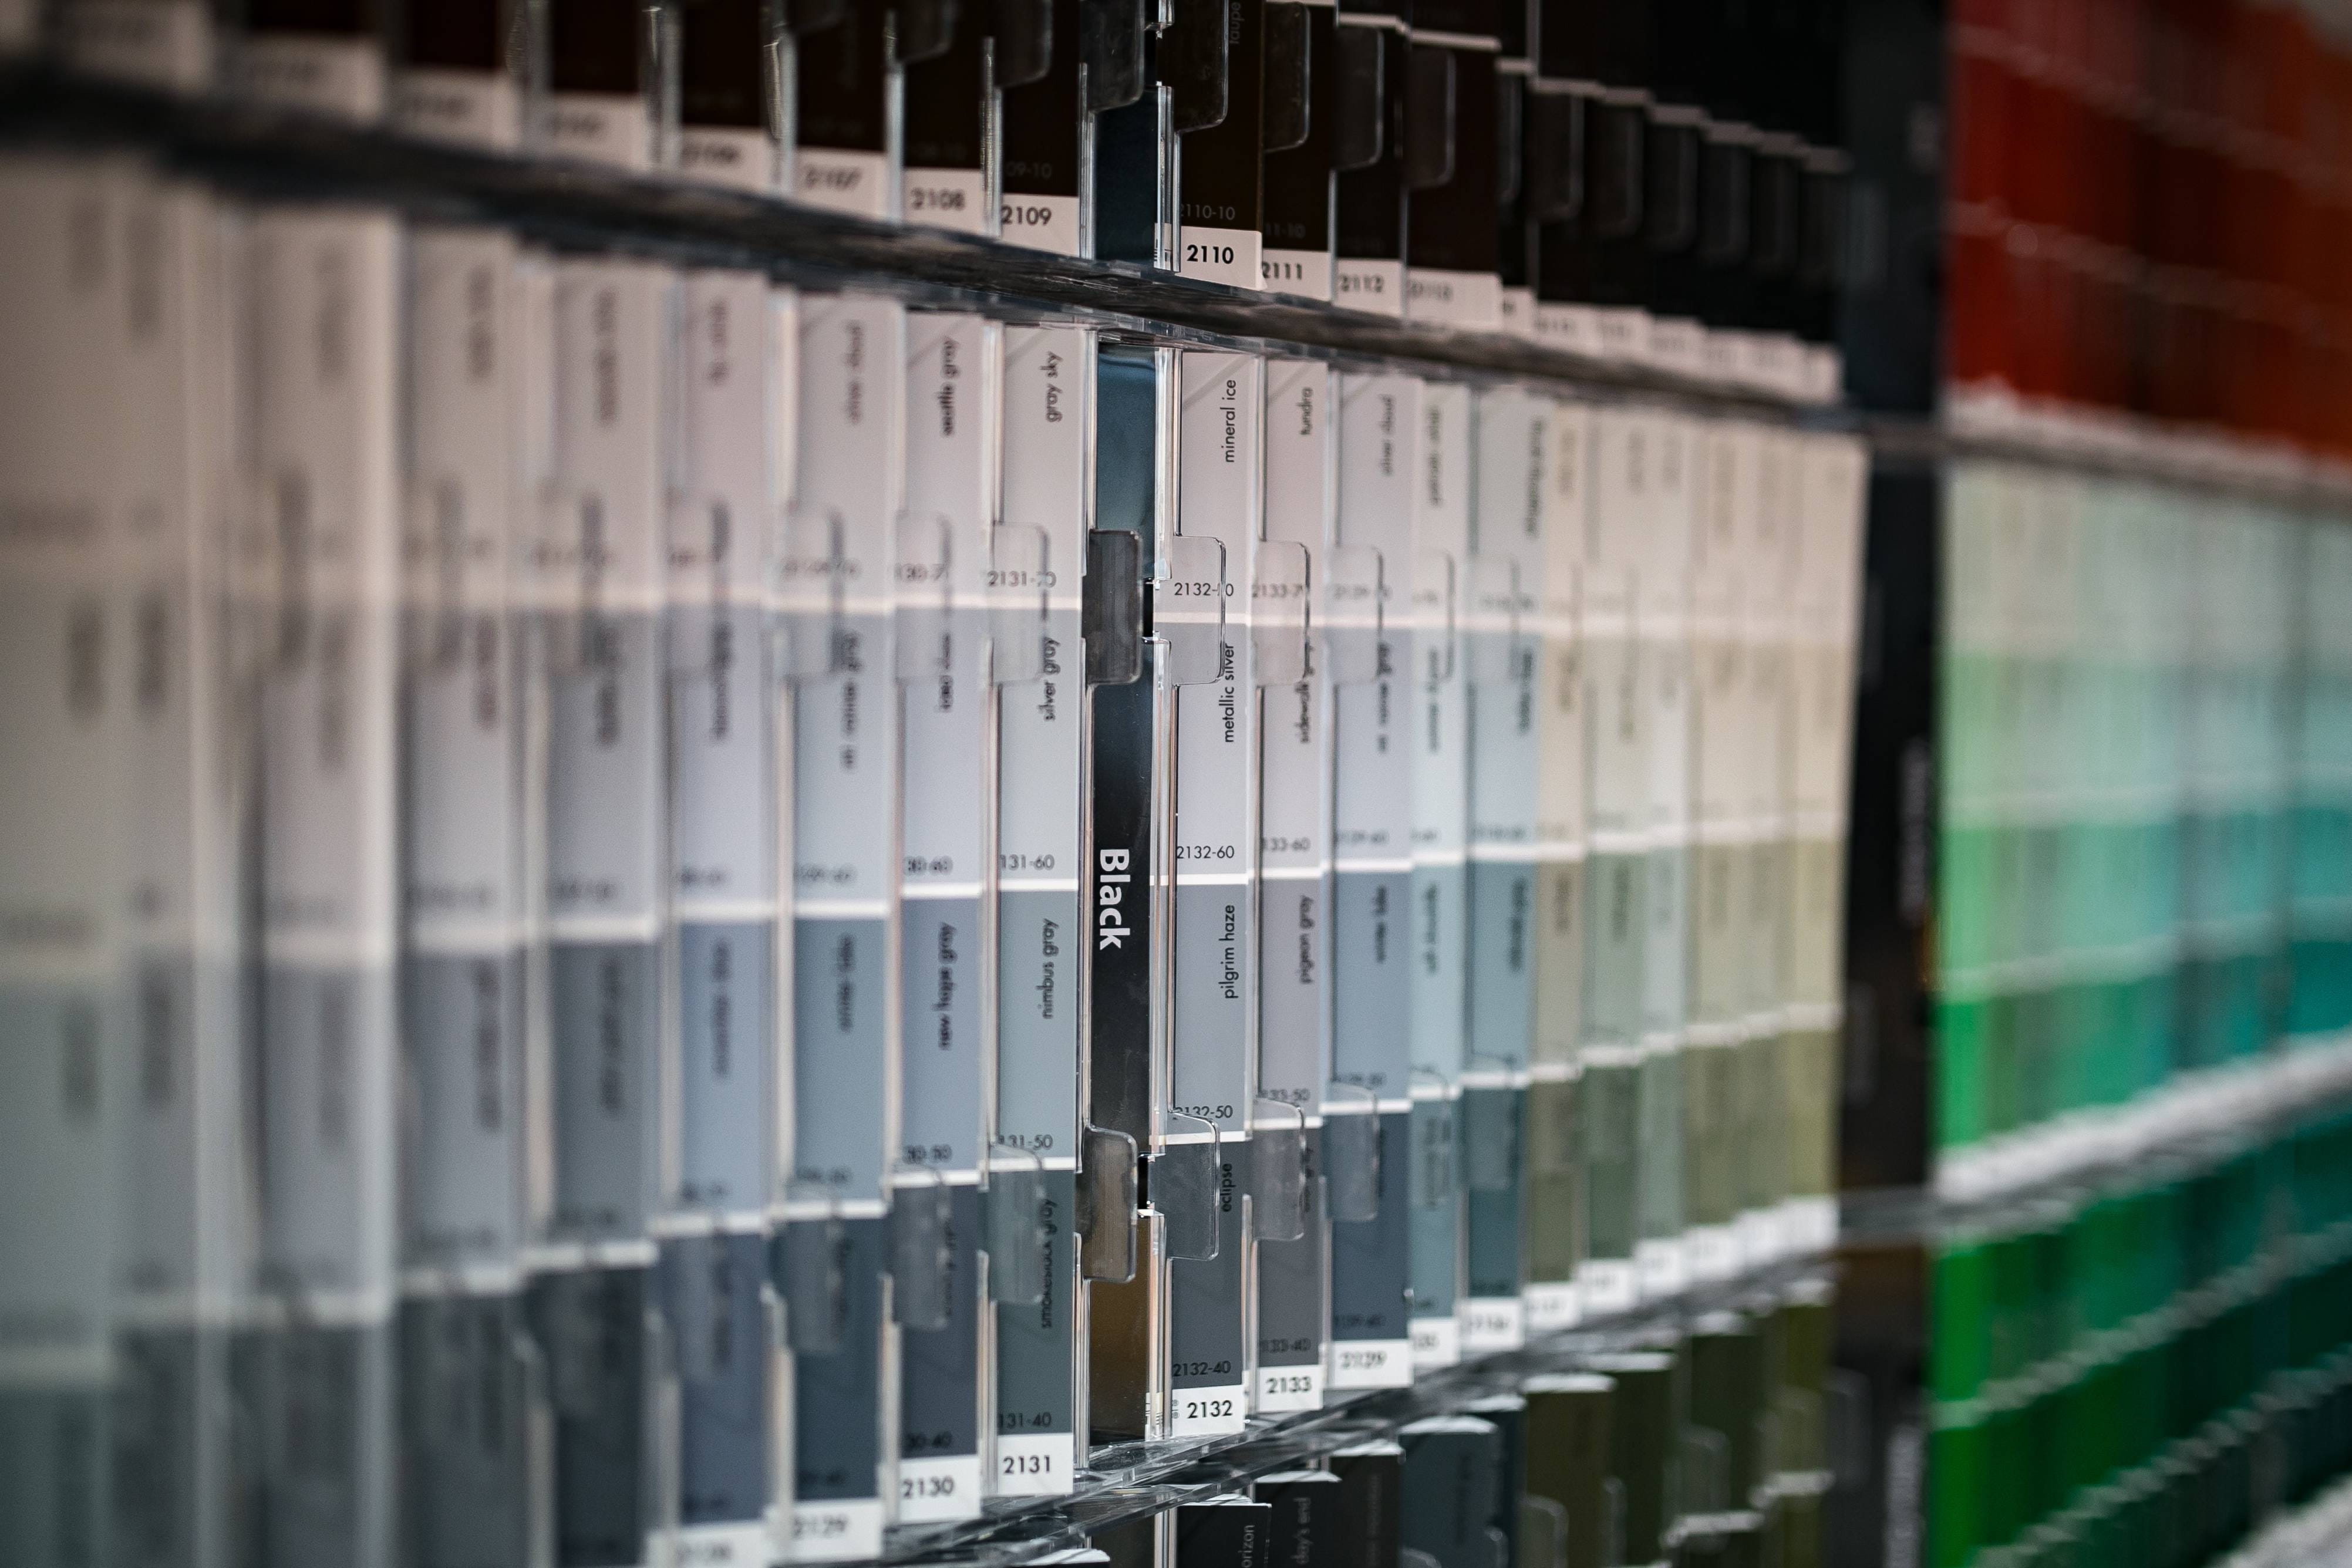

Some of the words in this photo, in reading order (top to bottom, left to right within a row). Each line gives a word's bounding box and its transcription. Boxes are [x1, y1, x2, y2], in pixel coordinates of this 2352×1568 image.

[911, 188, 966, 212] 2108
[1181, 204, 1235, 220] 2110-10
[1001, 204, 1052, 225] 2109
[1187, 244, 1234, 264] 2110
[1262, 261, 1302, 279] 2111
[1339, 274, 1386, 293] 2112
[1039, 351, 1063, 378] sky
[1222, 379, 1236, 401] ice
[1046, 384, 1063, 423] gray
[1297, 387, 1313, 436] tundra
[1221, 408, 1235, 463] mineral
[1174, 582, 1234, 597] 2132-0
[1252, 582, 1307, 598] 2133-7
[1042, 637, 1060, 675] gray
[1037, 682, 1056, 721] silver
[1219, 687, 1235, 743] metallic
[1177, 845, 1235, 859] 2132-60
[1099, 849, 1131, 950] Black
[1299, 895, 1315, 929] gray
[1219, 905, 1235, 939] haze
[939, 922, 958, 963] gray
[1043, 919, 1059, 957] gray
[1219, 948, 1239, 999] pilgrim
[1036, 961, 1054, 1019] nimbus
[1220, 1164, 1236, 1212] eclipse
[1173, 1361, 1231, 1377] 2132-40
[1266, 1376, 1312, 1394] 2133
[1187, 1400, 1233, 1419] 2132
[1003, 1455, 1051, 1474] 2131
[902, 1476, 954, 1498] 2130
